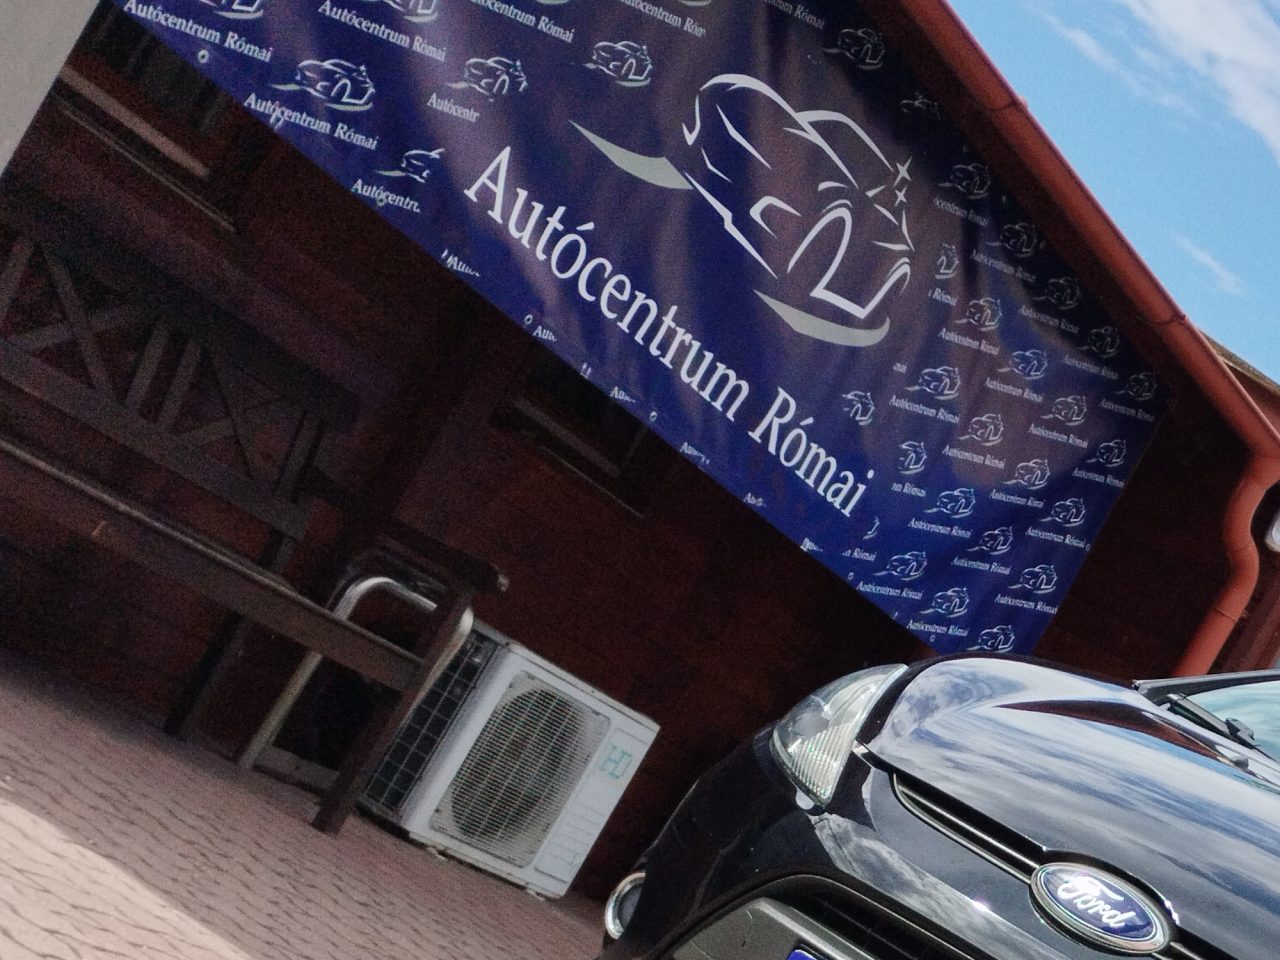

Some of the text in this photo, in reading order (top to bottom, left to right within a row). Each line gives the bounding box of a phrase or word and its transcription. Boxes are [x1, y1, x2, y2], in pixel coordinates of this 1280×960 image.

[123, 0, 273, 63] Autócentrum Római
[318, 0, 447, 62] Autócentrum Római
[537, 15, 575, 43] Római
[244, 93, 380, 151] Autócentrum Római
[464, 145, 875, 518] Autócentrum Római
[1057, 872, 1137, 929] Ford
